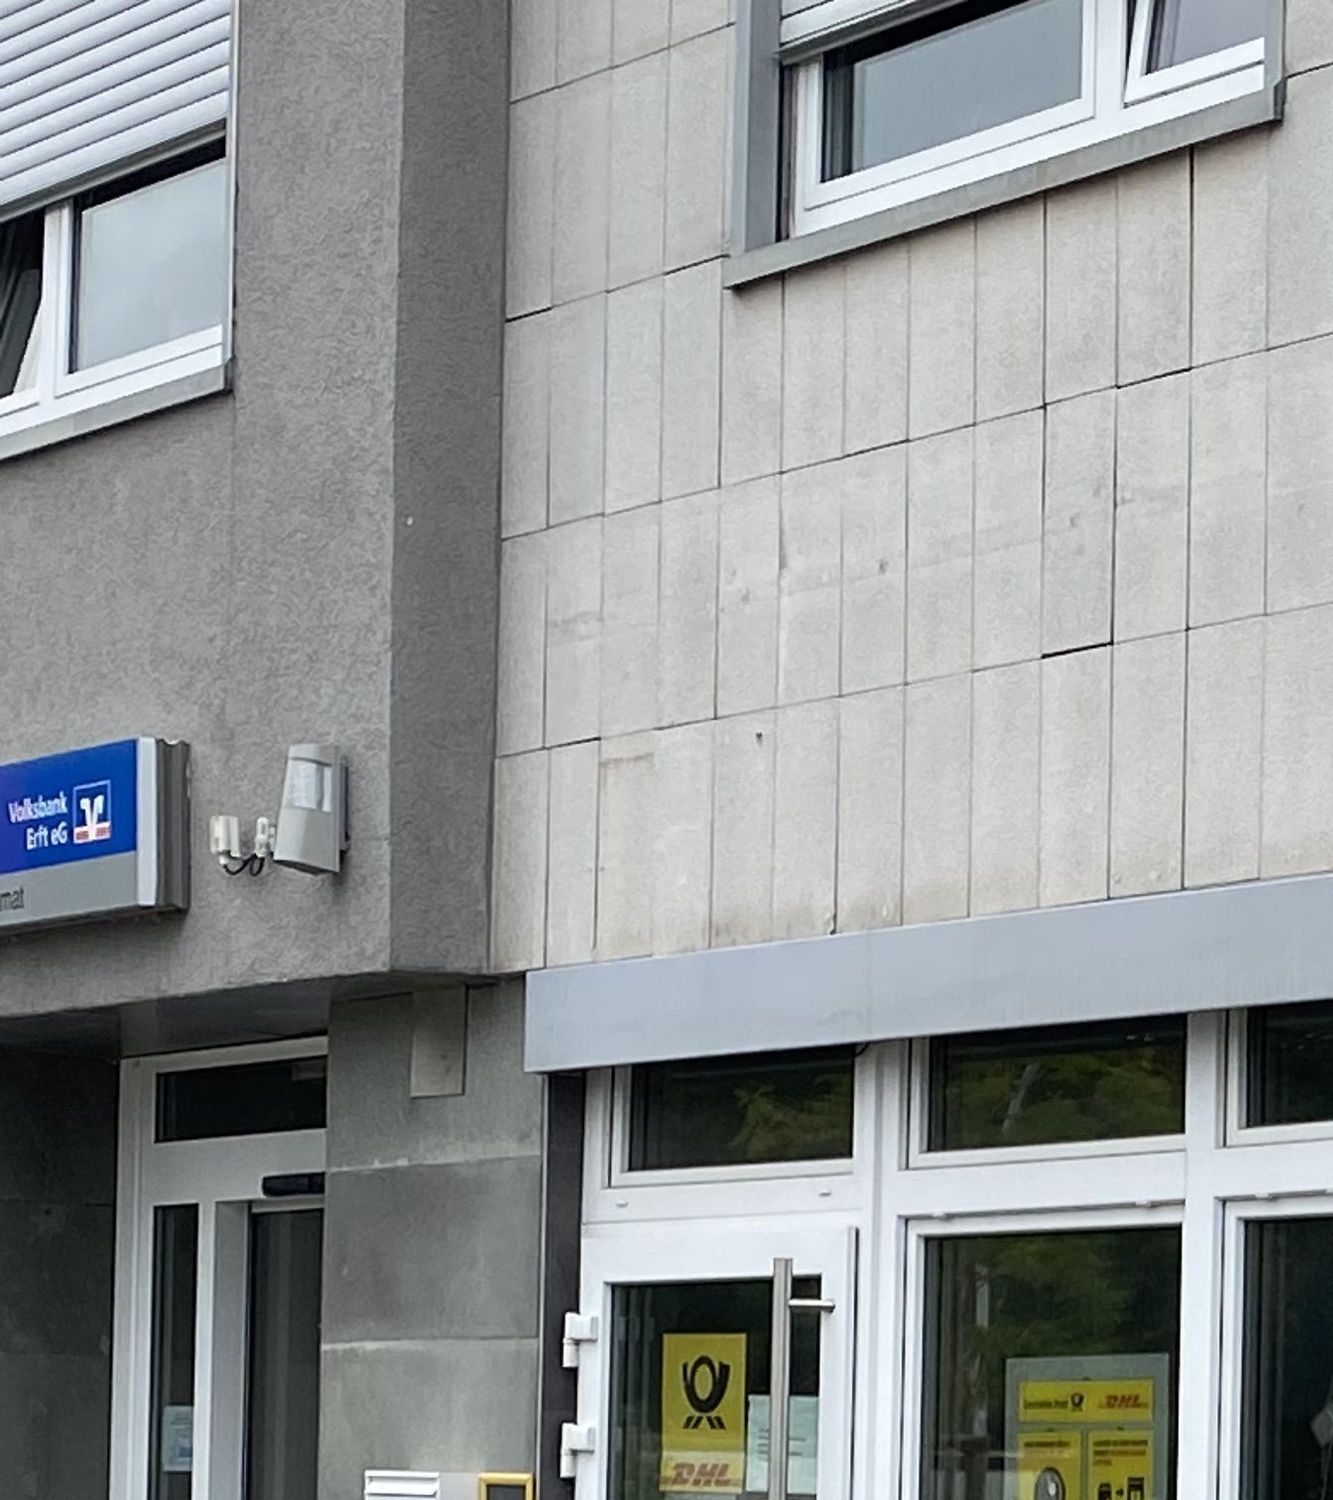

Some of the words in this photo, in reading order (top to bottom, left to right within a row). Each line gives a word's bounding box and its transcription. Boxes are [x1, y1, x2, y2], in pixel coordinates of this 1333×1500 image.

[8, 791, 68, 823] Volksbank
[26, 824, 49, 850] Erft
[50, 821, 68, 845] eG
[1105, 1394, 1141, 1409] DHL
[671, 1463, 732, 1487] DHL
